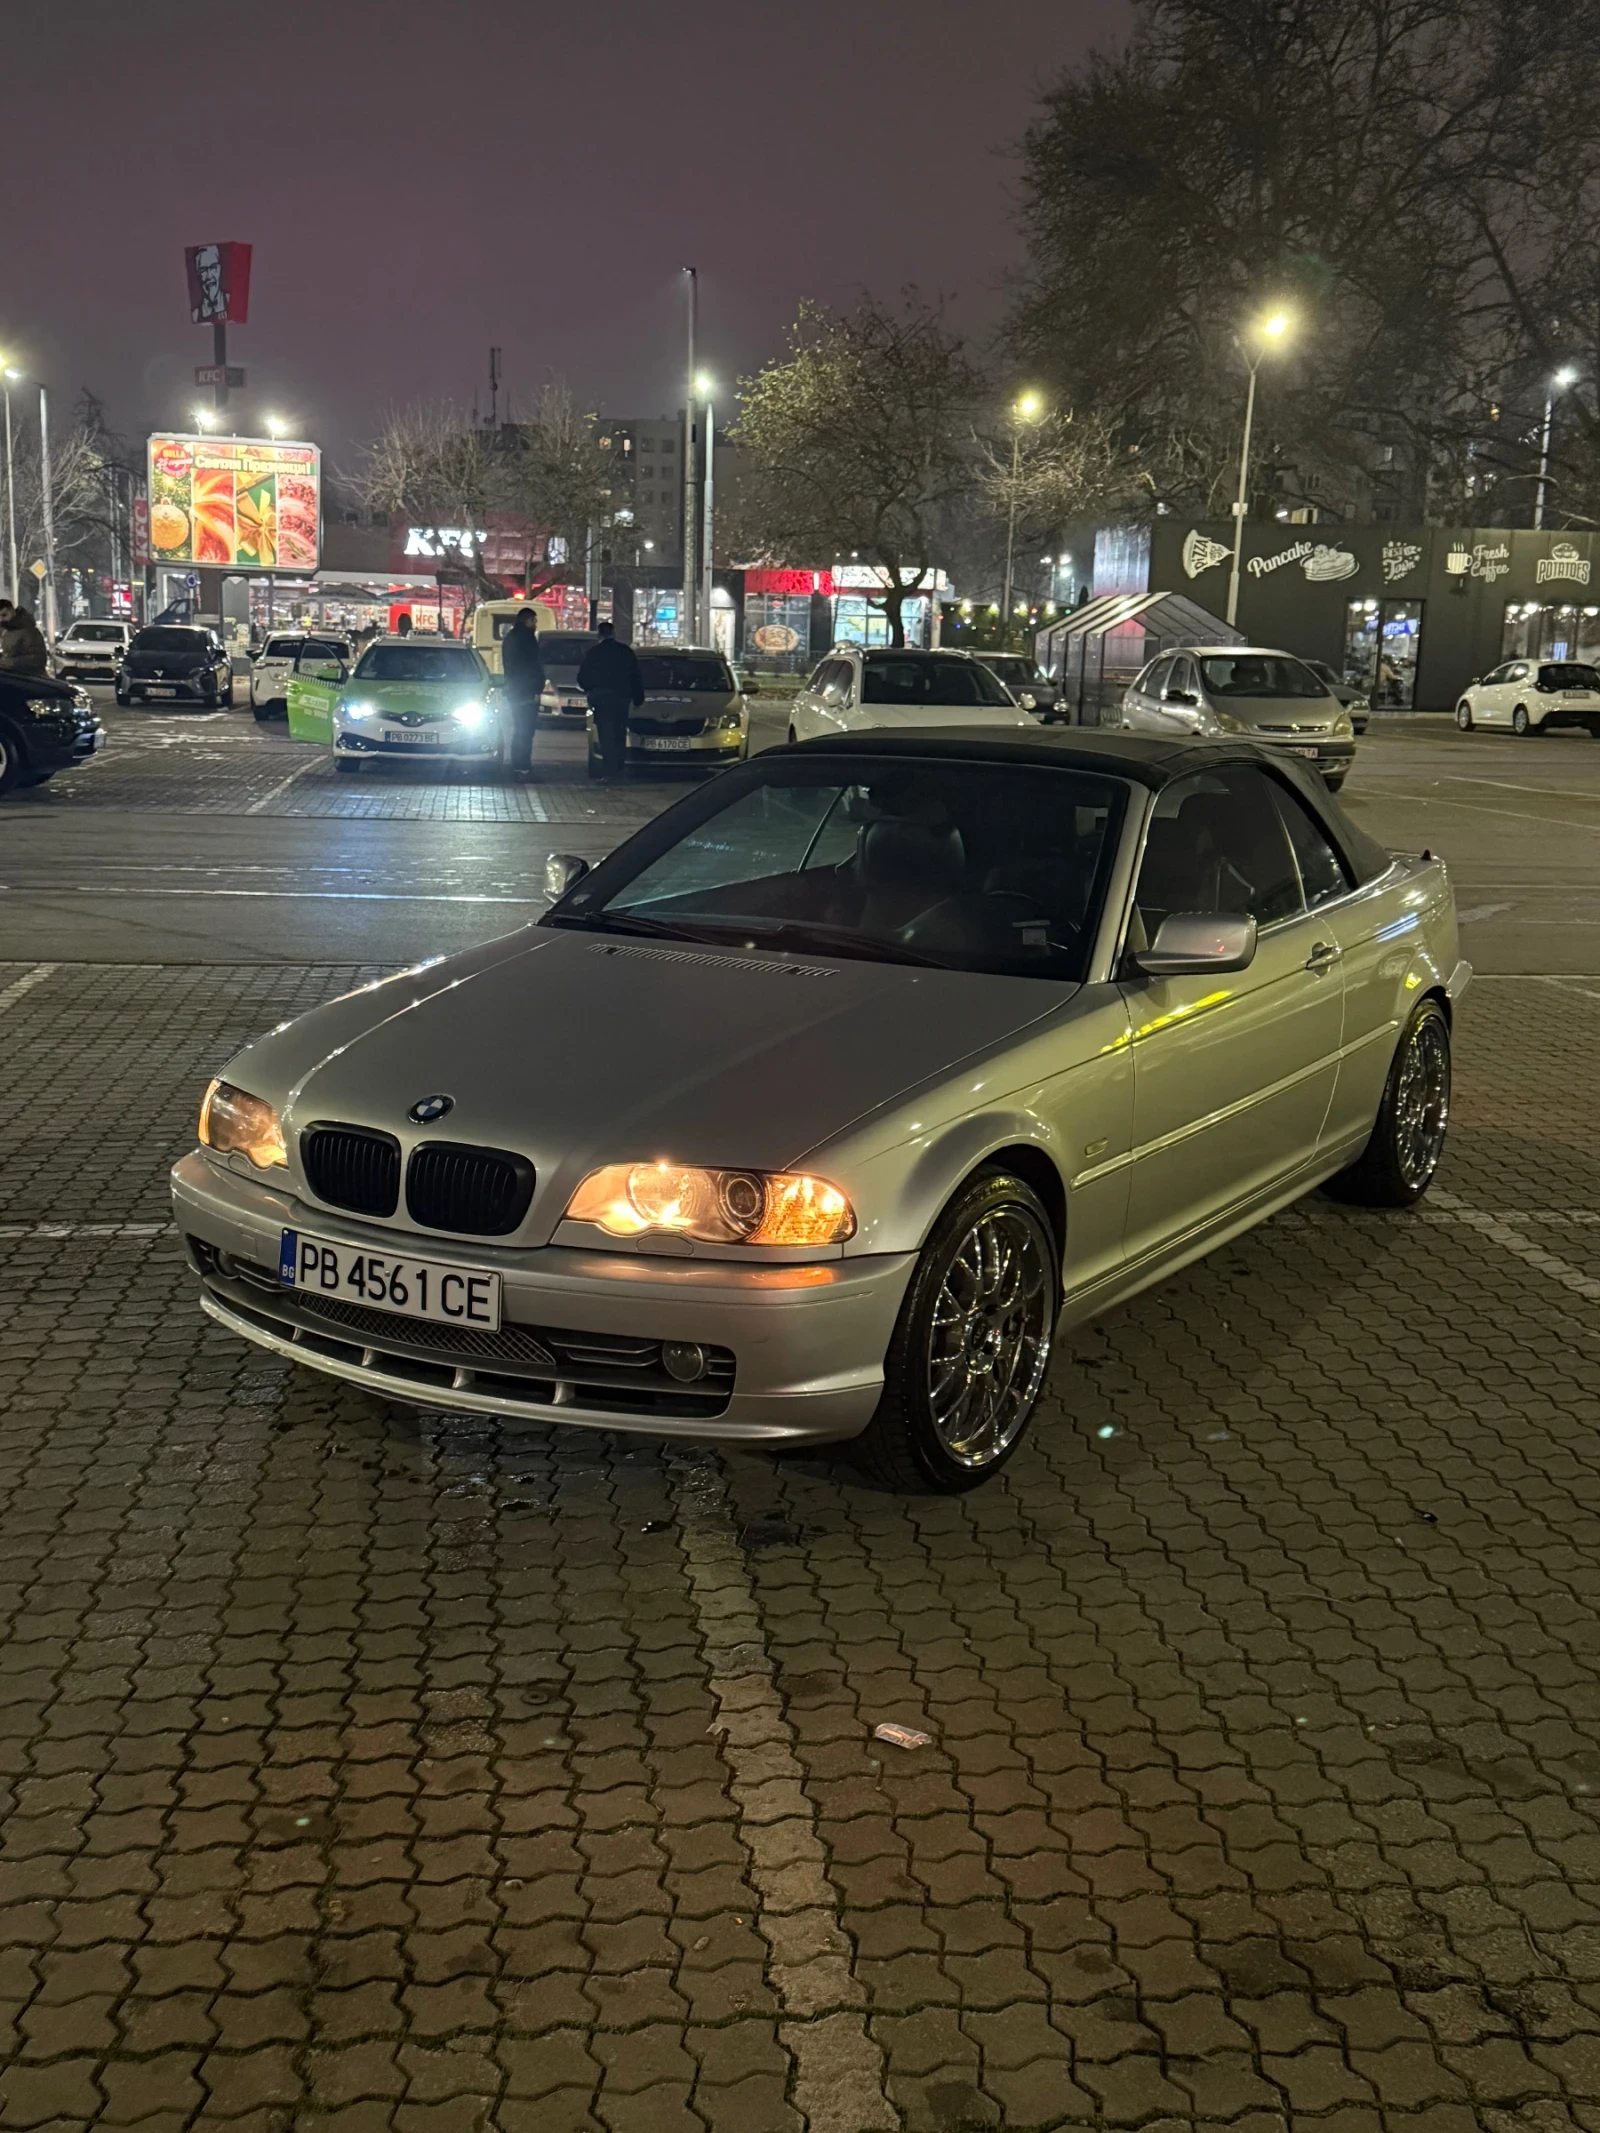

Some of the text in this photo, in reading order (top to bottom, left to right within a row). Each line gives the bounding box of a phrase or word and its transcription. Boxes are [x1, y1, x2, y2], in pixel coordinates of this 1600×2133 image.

[198, 369, 221, 383] KFC
[135, 505, 149, 557] KFC
[1247, 541, 1314, 579] Pancake
[1382, 547, 1403, 559] BEST
[1473, 543, 1510, 561] Fresh
[1382, 556, 1416, 580] Town
[1470, 560, 1510, 582] Coffee
[1536, 560, 1591, 585] POTATOES
[404, 733, 424, 742] 0273
[657, 739, 677, 749] 6170
[677, 739, 689, 749] CE
[282, 1264, 294, 1279] BG
[301, 1242, 491, 1323] PB 4561 CE
